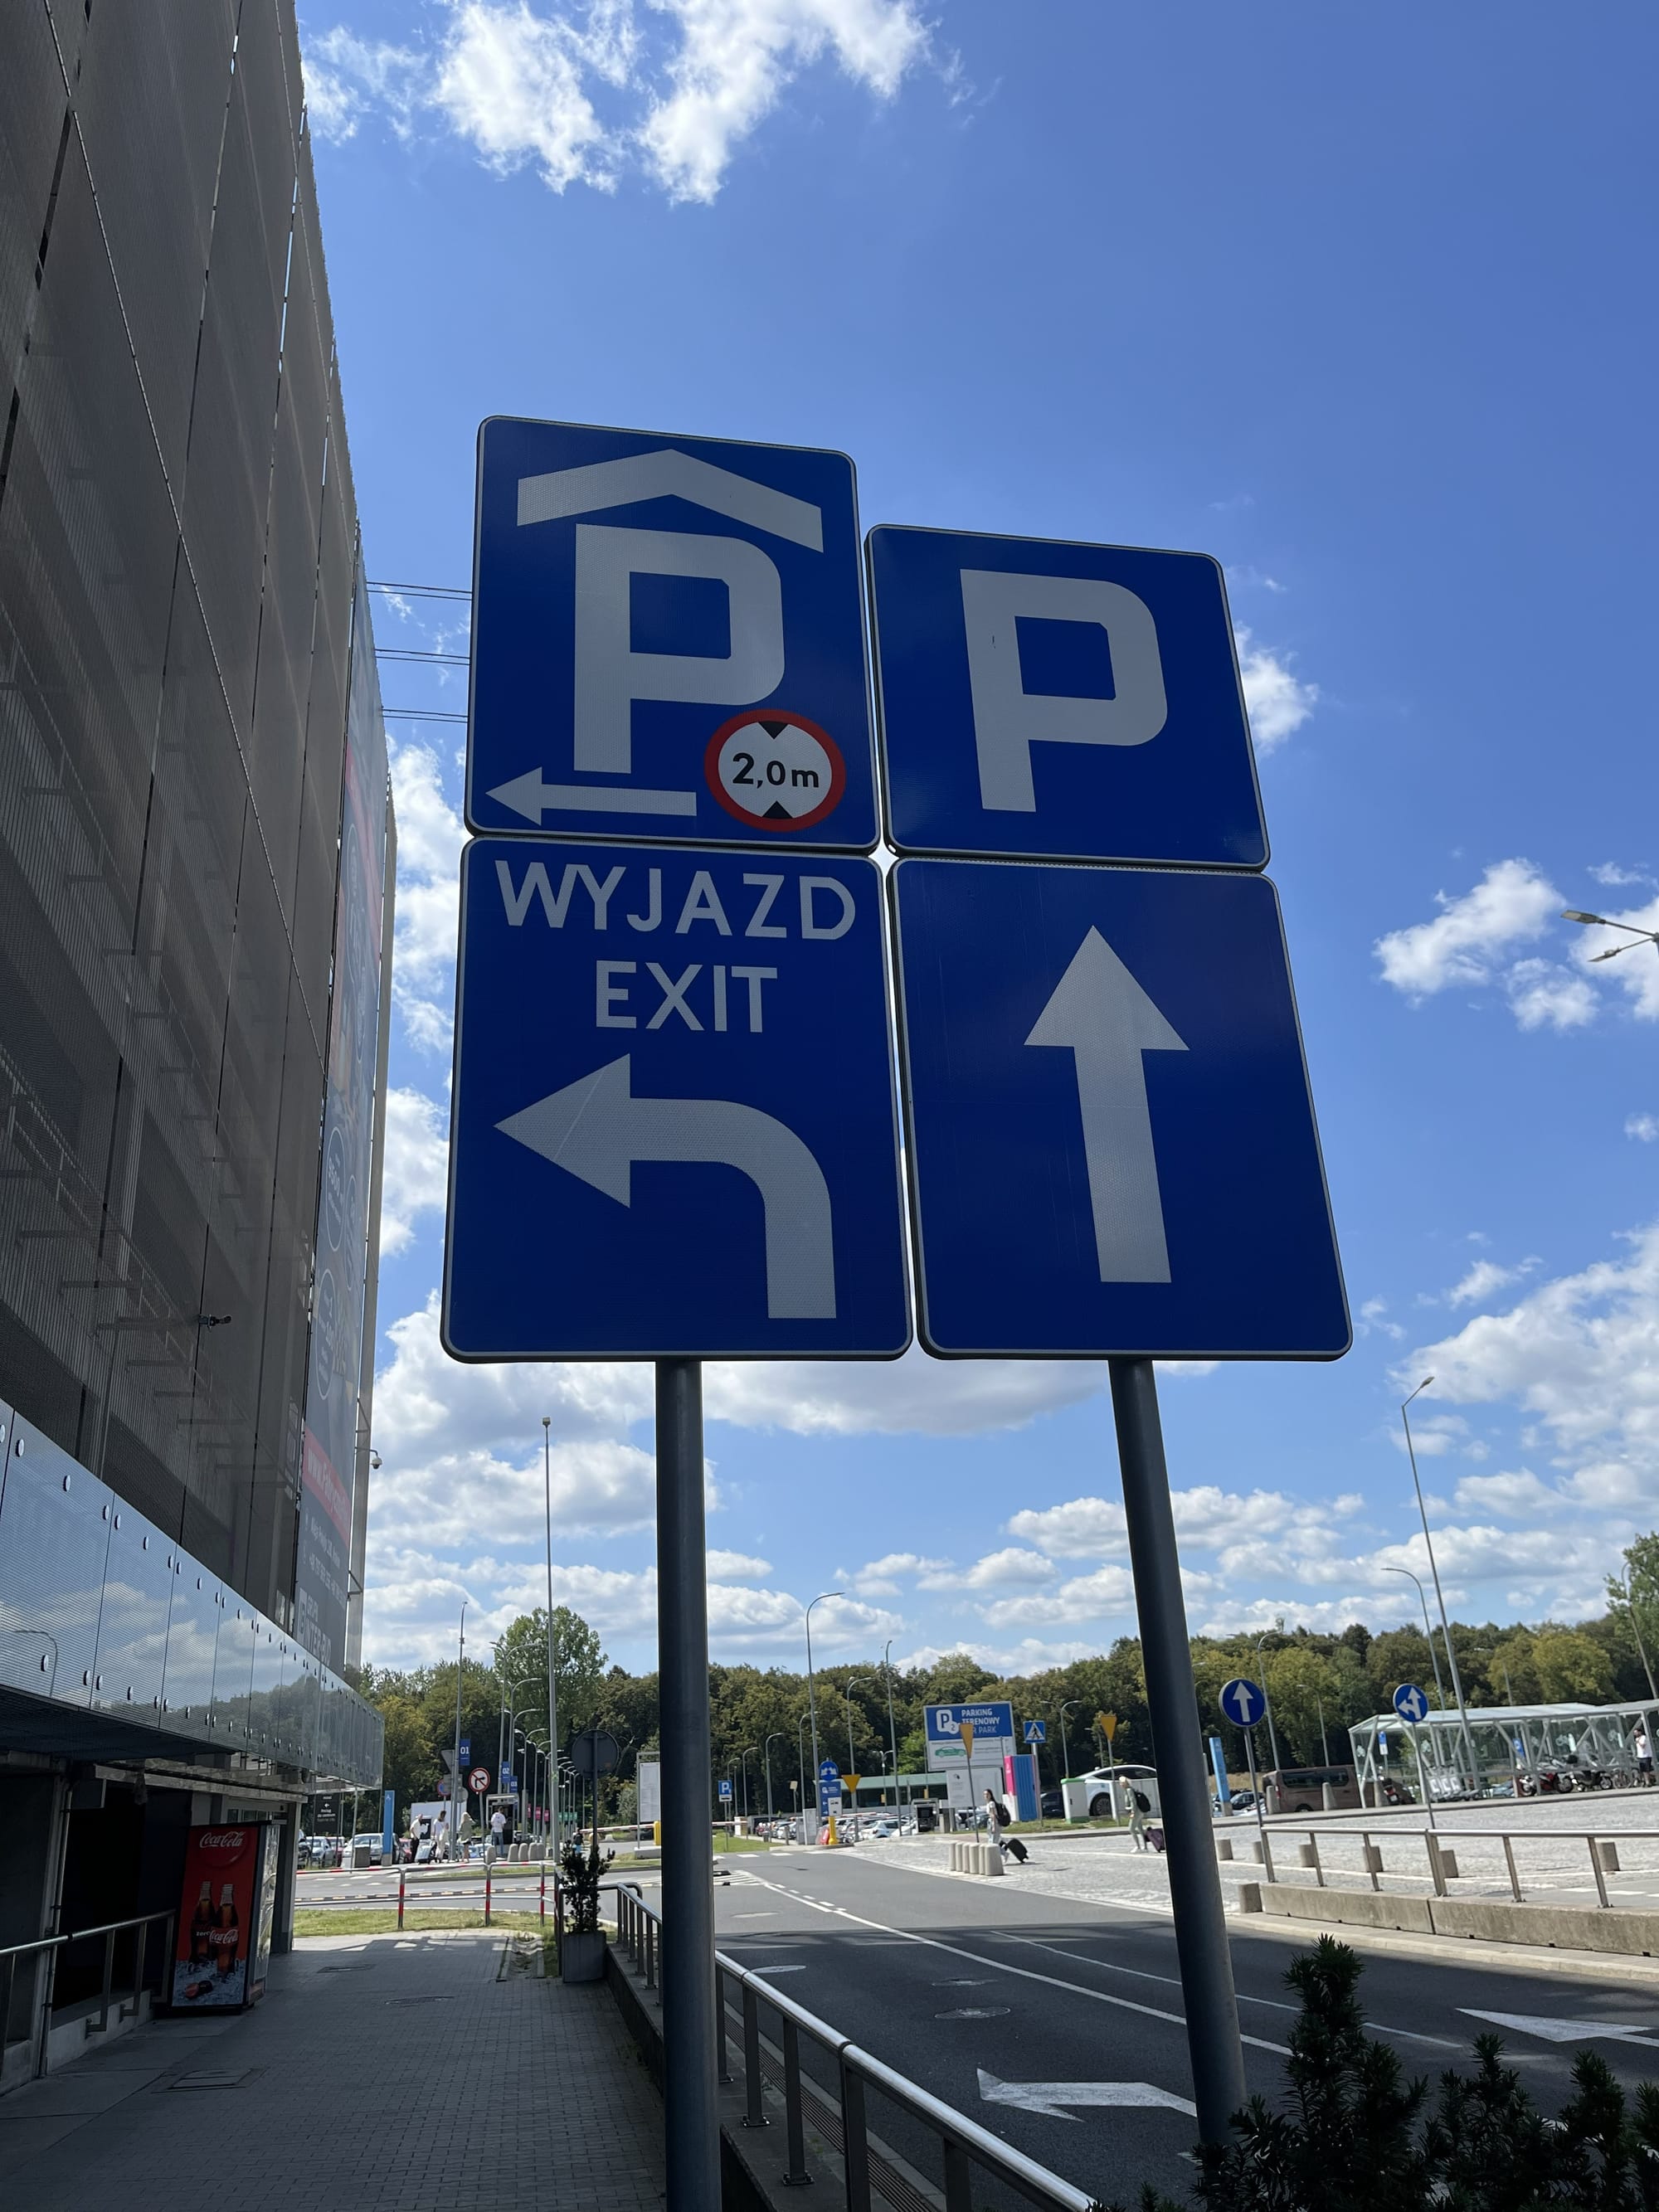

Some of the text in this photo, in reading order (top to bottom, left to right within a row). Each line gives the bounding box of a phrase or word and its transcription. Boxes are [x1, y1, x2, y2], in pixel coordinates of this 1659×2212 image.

[574, 523, 785, 775] P
[960, 569, 1168, 813] P
[494, 860, 856, 941] WYJAZD
[596, 960, 778, 1033] EXIT
[961, 1709, 993, 1717] PARKING
[722, 1782, 730, 1794] P
